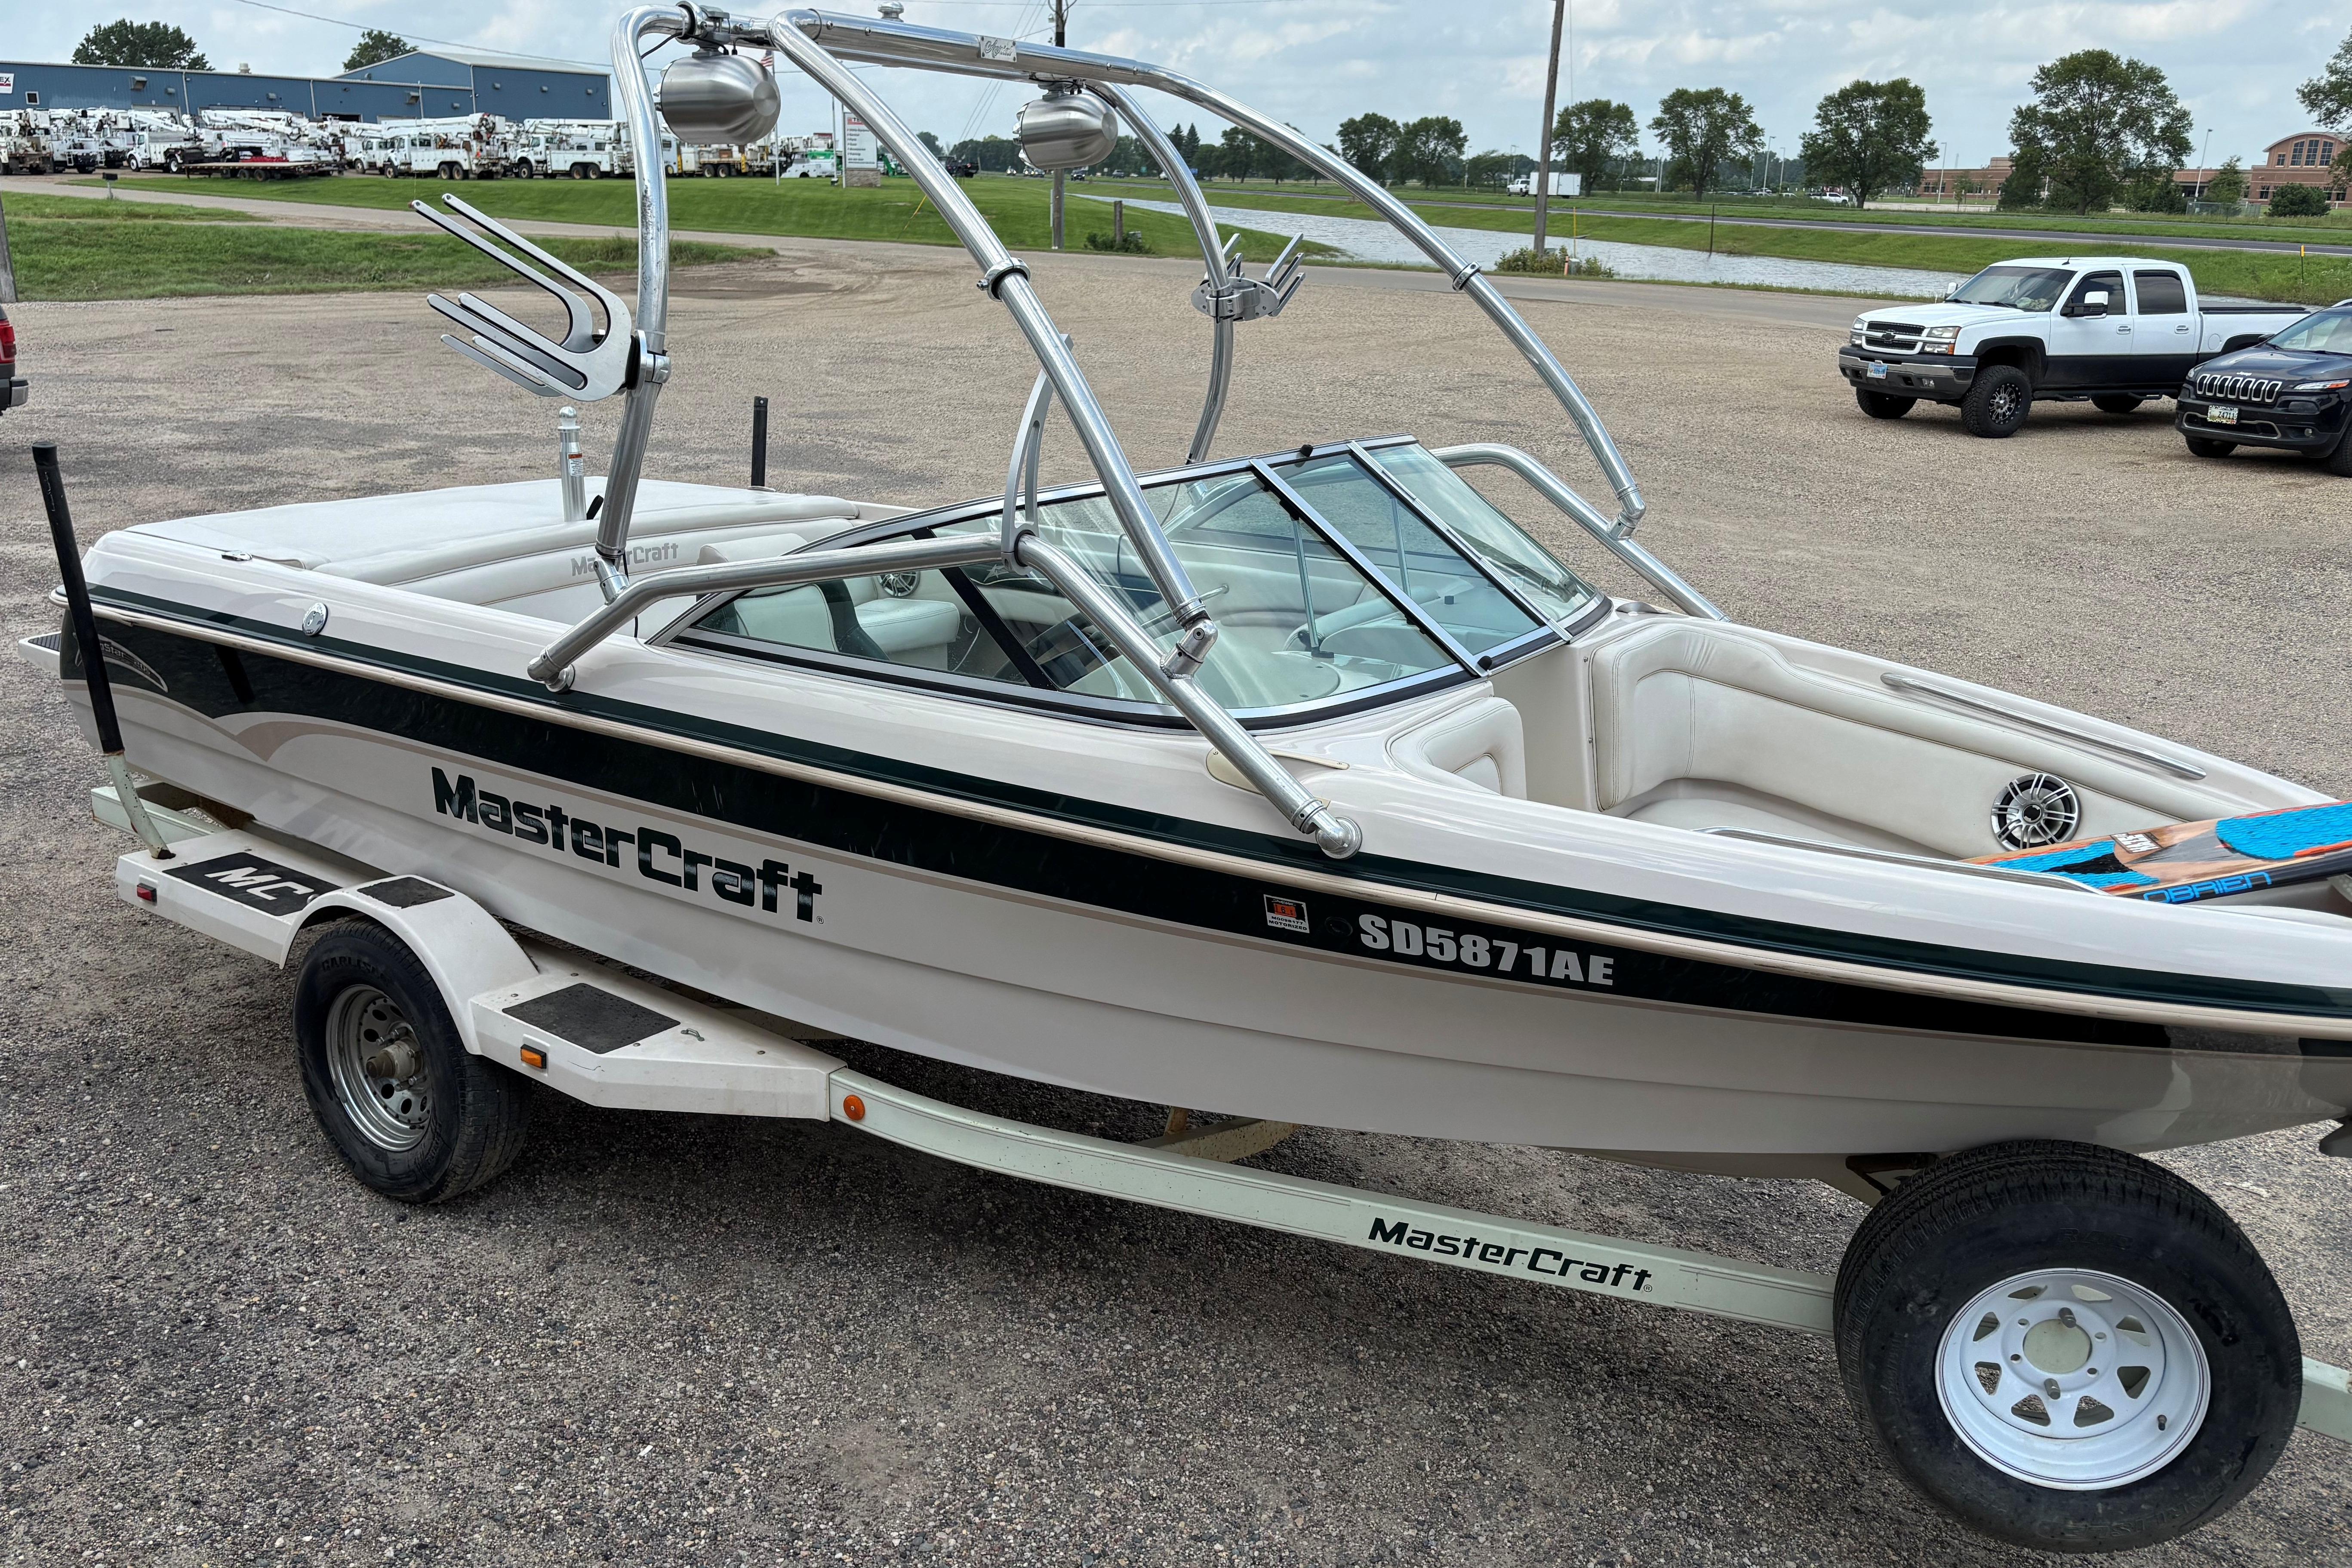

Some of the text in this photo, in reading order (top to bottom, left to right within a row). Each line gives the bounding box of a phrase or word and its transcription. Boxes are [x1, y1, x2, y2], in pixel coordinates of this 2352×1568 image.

[570, 543, 678, 576] MarCraft
[431, 767, 822, 922] MasterCraft
[204, 866, 315, 901] MC
[1269, 920, 1307, 930] MOTORIZED
[1359, 914, 1613, 986] SD5871AE
[1368, 1217, 1652, 1291] MasterCraft
